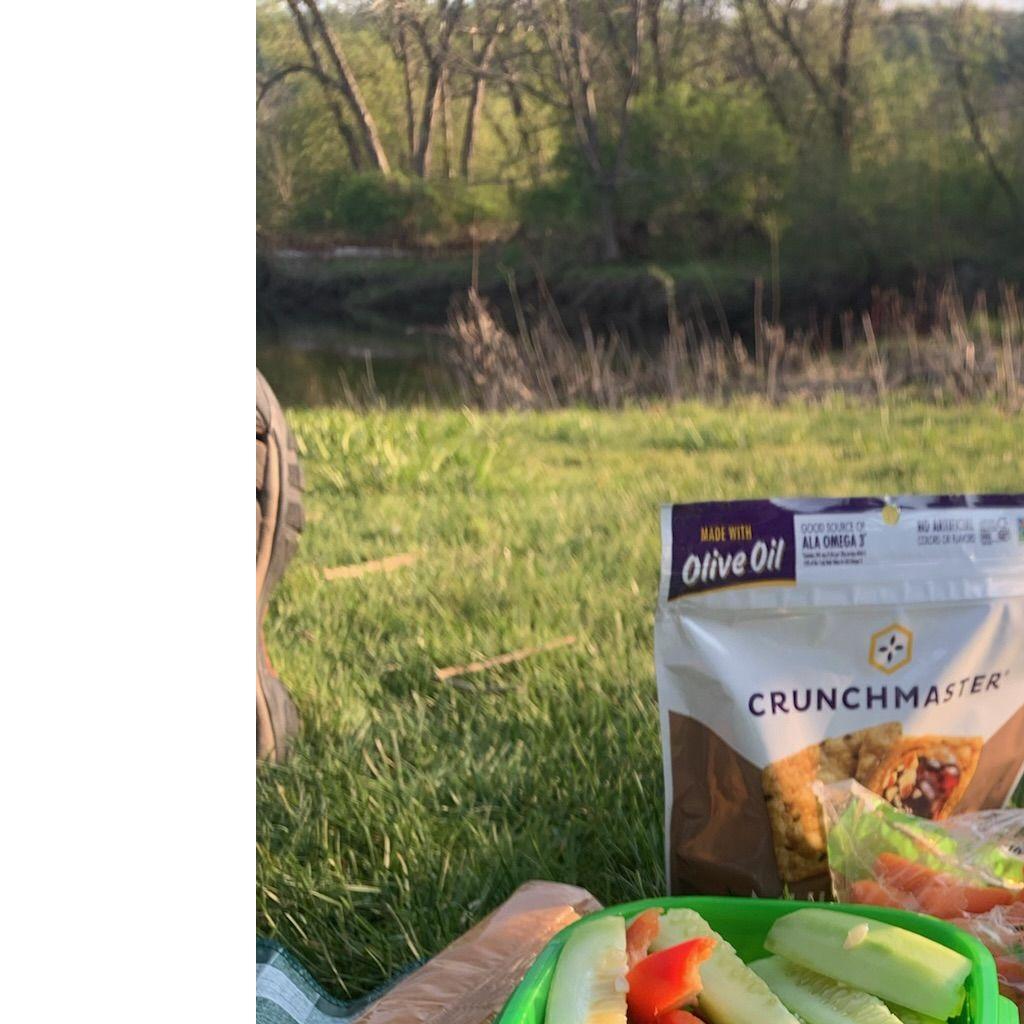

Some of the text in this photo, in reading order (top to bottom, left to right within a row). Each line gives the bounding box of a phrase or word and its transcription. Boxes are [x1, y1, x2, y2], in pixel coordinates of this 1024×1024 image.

[701, 525, 752, 541] MADE WITH
[801, 522, 825, 534] GOOD
[826, 521, 854, 533] SOURCE
[917, 520, 929, 532] NO
[802, 535, 821, 550] ALA
[823, 534, 857, 549] OMEGA
[682, 538, 784, 585] Olive Oil
[748, 672, 1003, 716] CRUNCHMASTER
